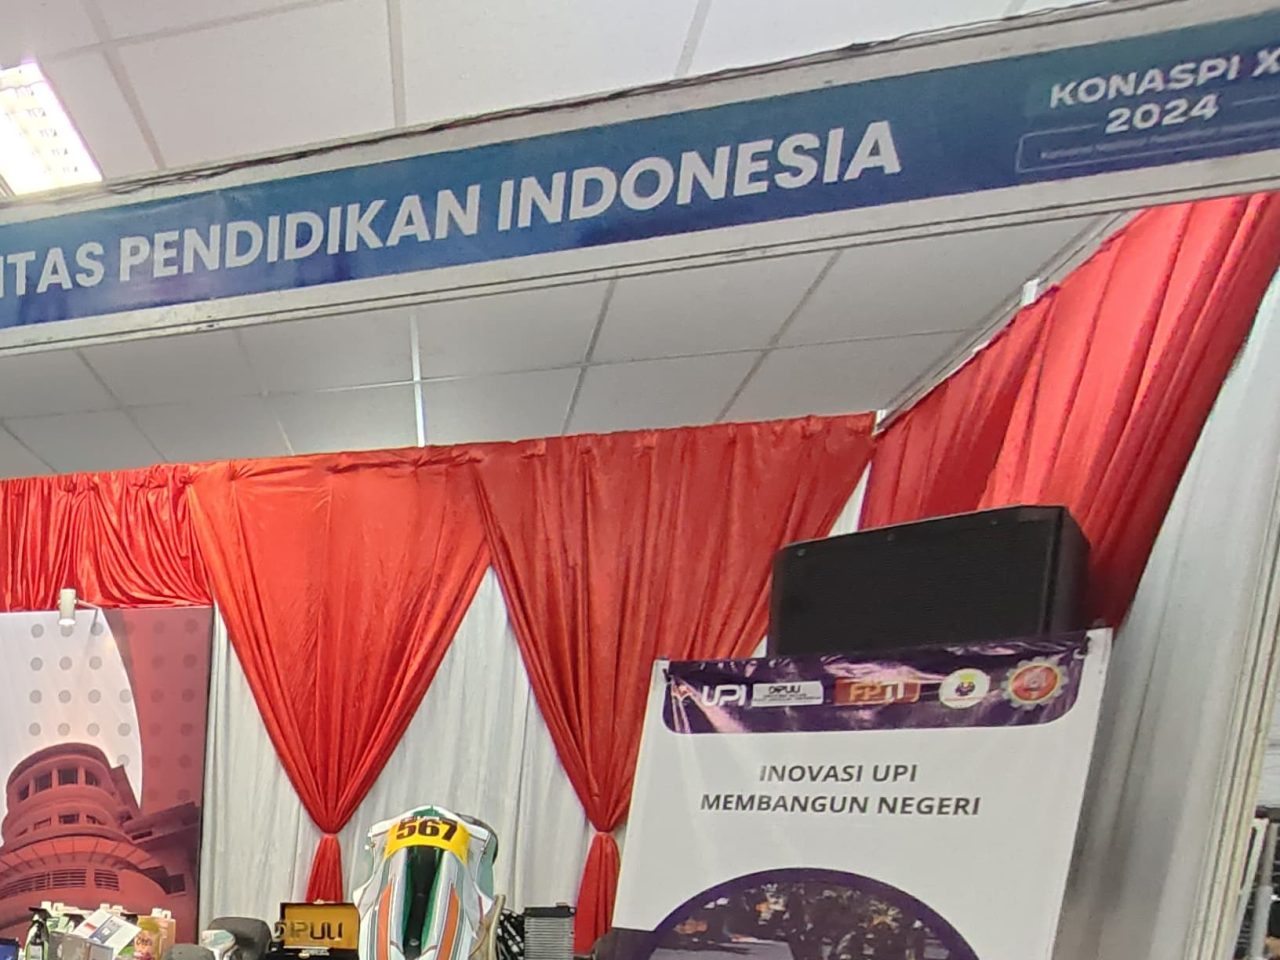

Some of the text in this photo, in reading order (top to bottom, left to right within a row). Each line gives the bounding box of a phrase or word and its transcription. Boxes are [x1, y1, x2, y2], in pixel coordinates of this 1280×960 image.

[1050, 48, 1280, 108] KONASPI X
[1105, 93, 1219, 134] 2024
[120, 185, 479, 281] PENDIDIKAN
[499, 120, 902, 229] INDONESIA
[702, 684, 746, 706] UPI
[759, 764, 918, 783] INOVASI UPI
[700, 794, 981, 816] MEMBANGUN NEGERI
[396, 816, 458, 842] 567
